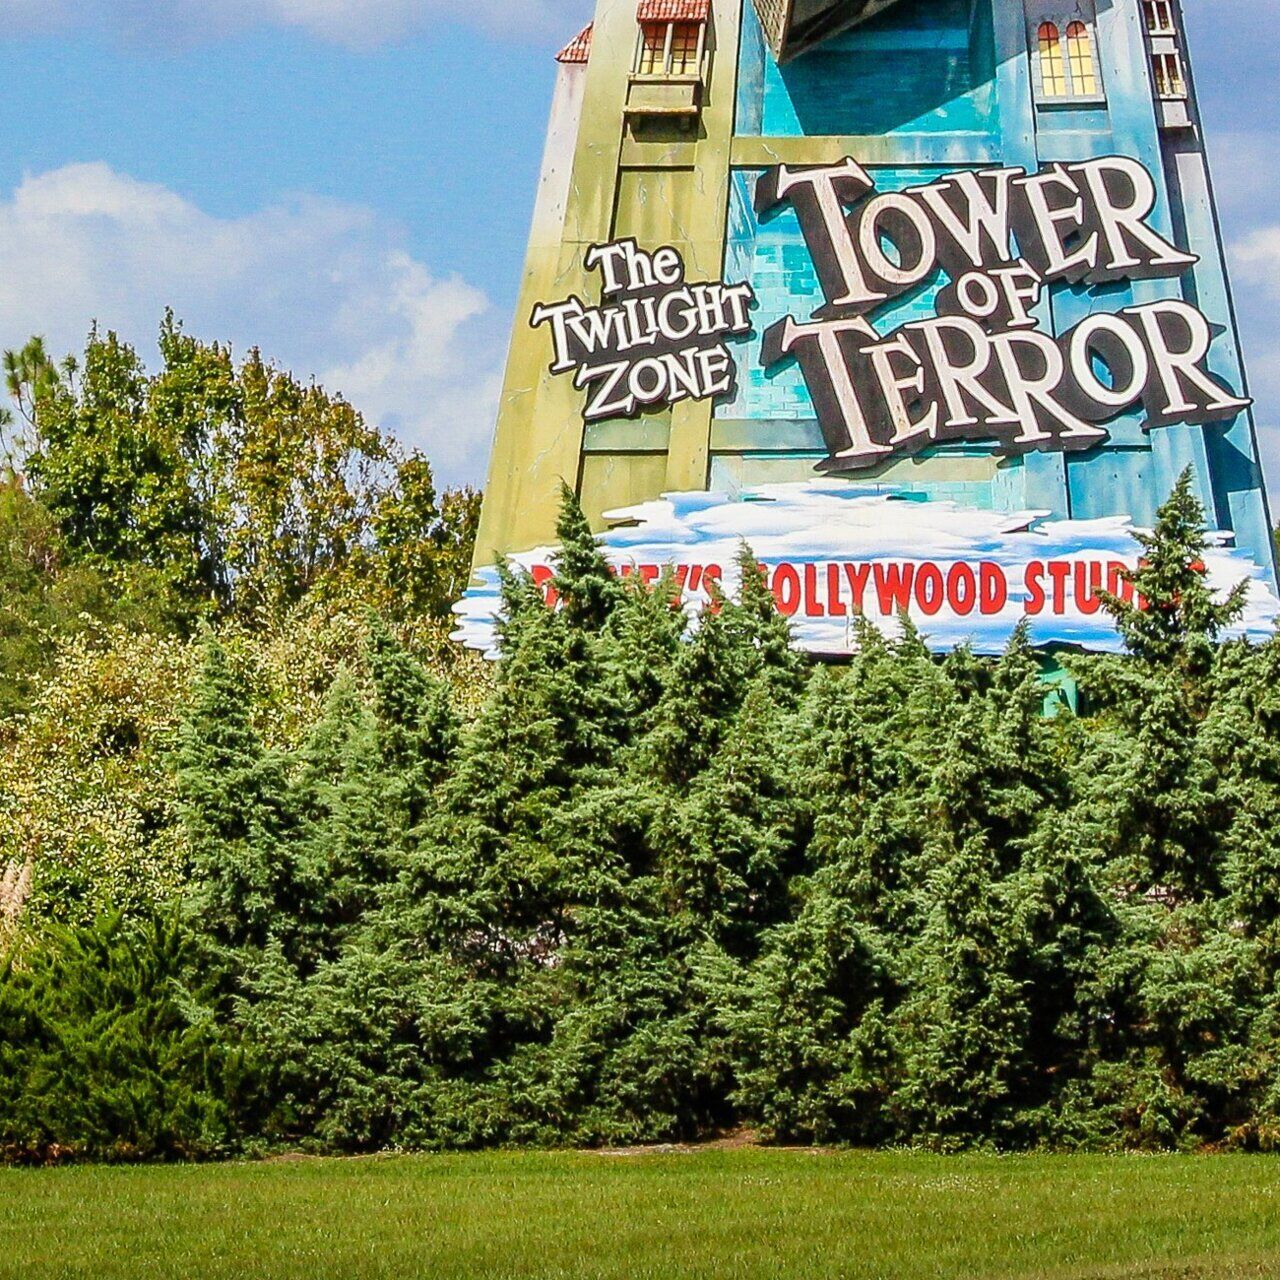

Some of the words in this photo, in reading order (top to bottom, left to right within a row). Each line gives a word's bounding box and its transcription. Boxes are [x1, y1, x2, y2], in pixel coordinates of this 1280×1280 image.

[586, 240, 680, 294] The
[776, 156, 1200, 305] TOWER
[531, 285, 753, 371] TWILIGHT
[956, 259, 1041, 327] OF
[575, 344, 730, 417] ZONE
[781, 299, 1251, 458] TERROR
[1023, 559, 1206, 615] STUD
